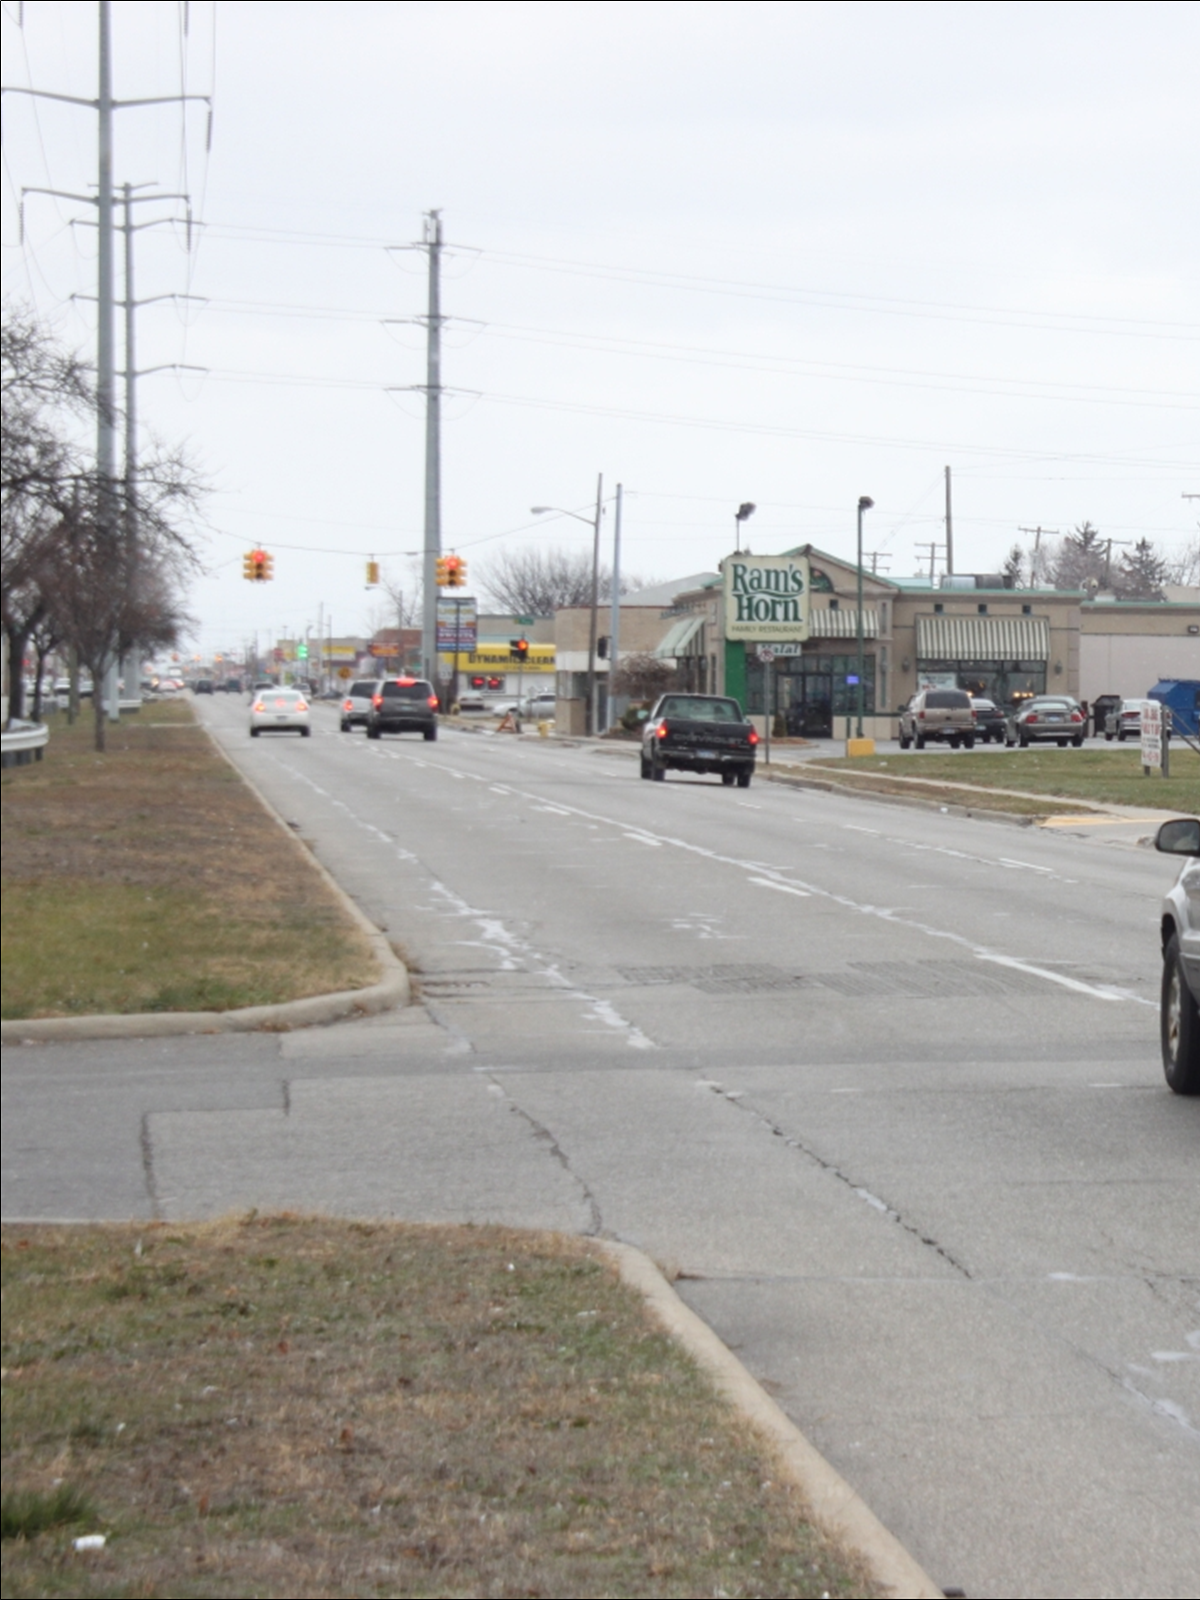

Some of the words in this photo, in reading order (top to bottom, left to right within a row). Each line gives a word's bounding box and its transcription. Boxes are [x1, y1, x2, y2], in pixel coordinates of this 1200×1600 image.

[731, 563, 804, 597] Ram's
[732, 594, 803, 622] Horn
[672, 732, 744, 746] CHEVROLET
